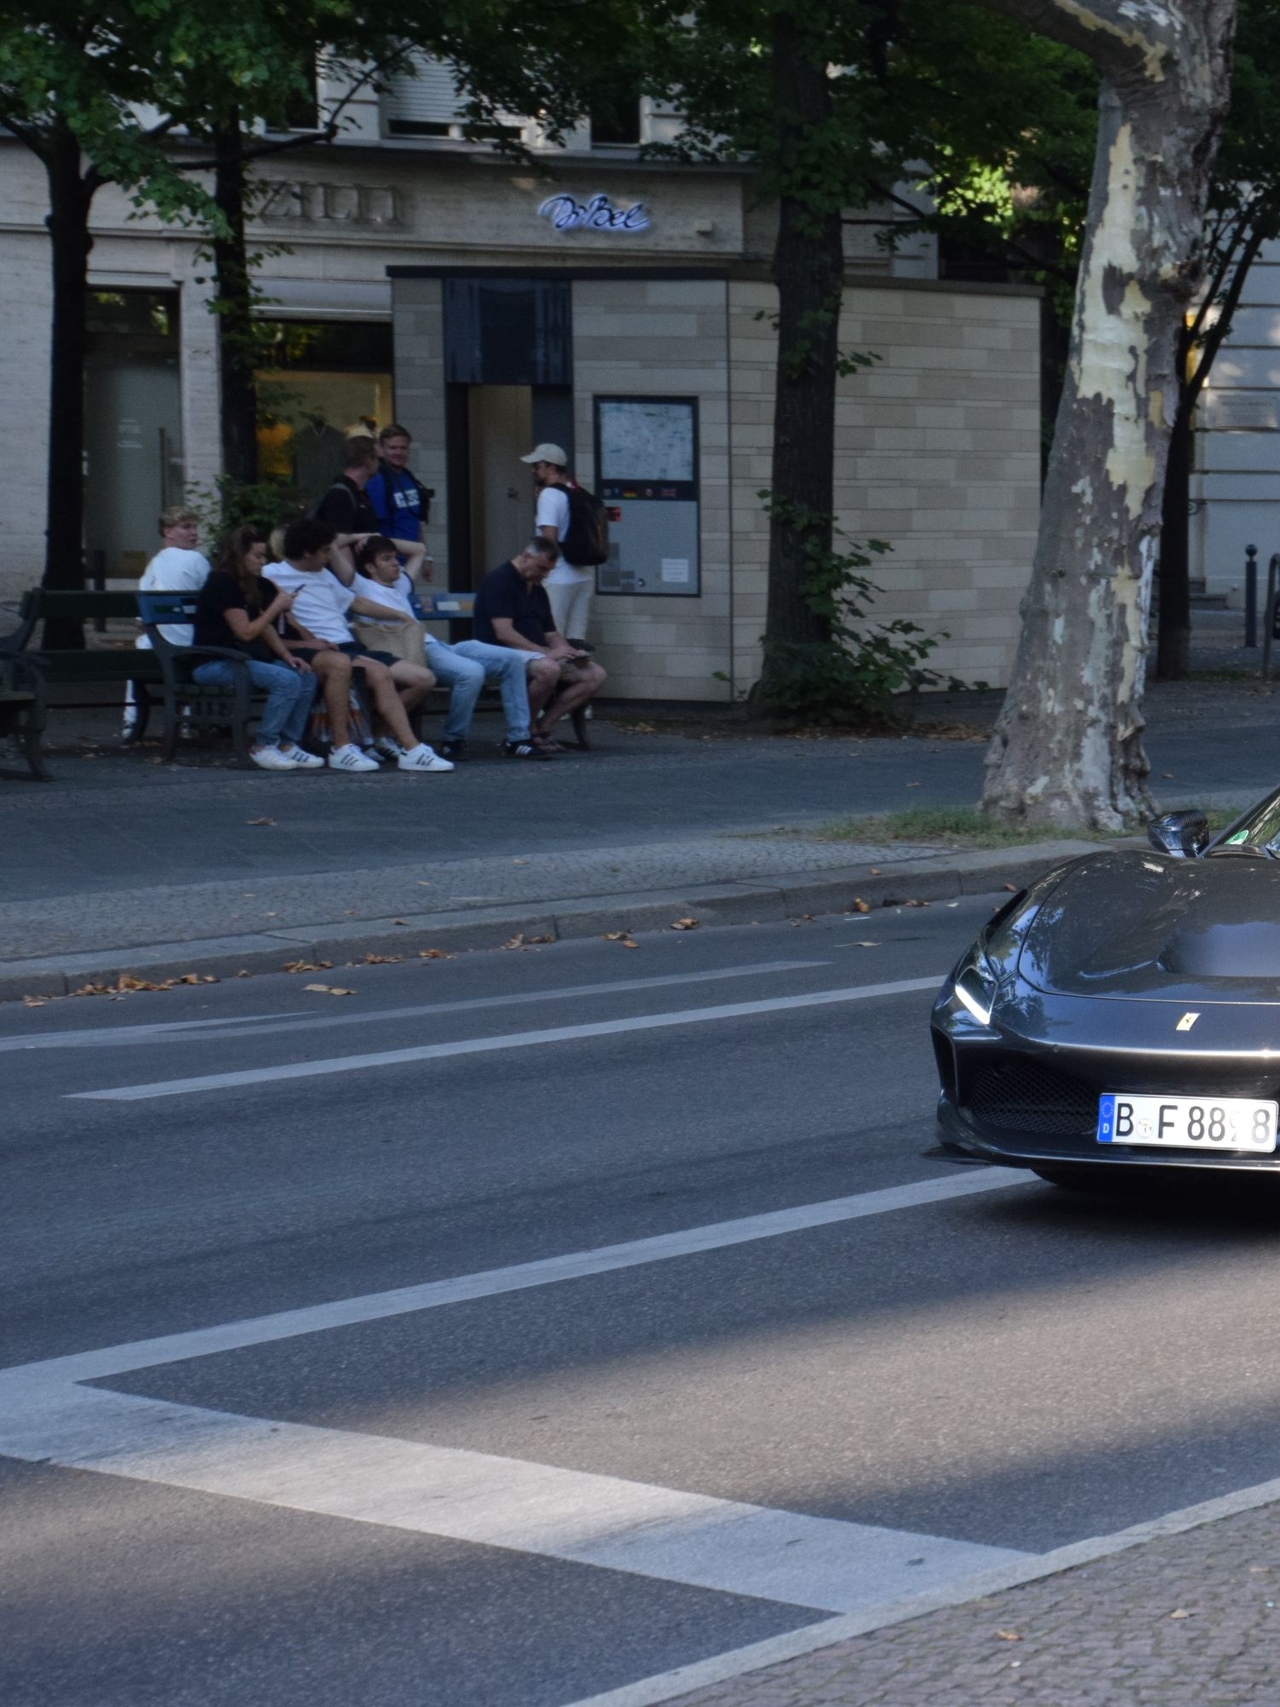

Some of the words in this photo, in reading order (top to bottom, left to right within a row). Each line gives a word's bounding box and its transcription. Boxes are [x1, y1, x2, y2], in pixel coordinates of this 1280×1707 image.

[1115, 1102, 1134, 1137] B
[1157, 1104, 1179, 1139] F
[1187, 1105, 1271, 1144] 888
